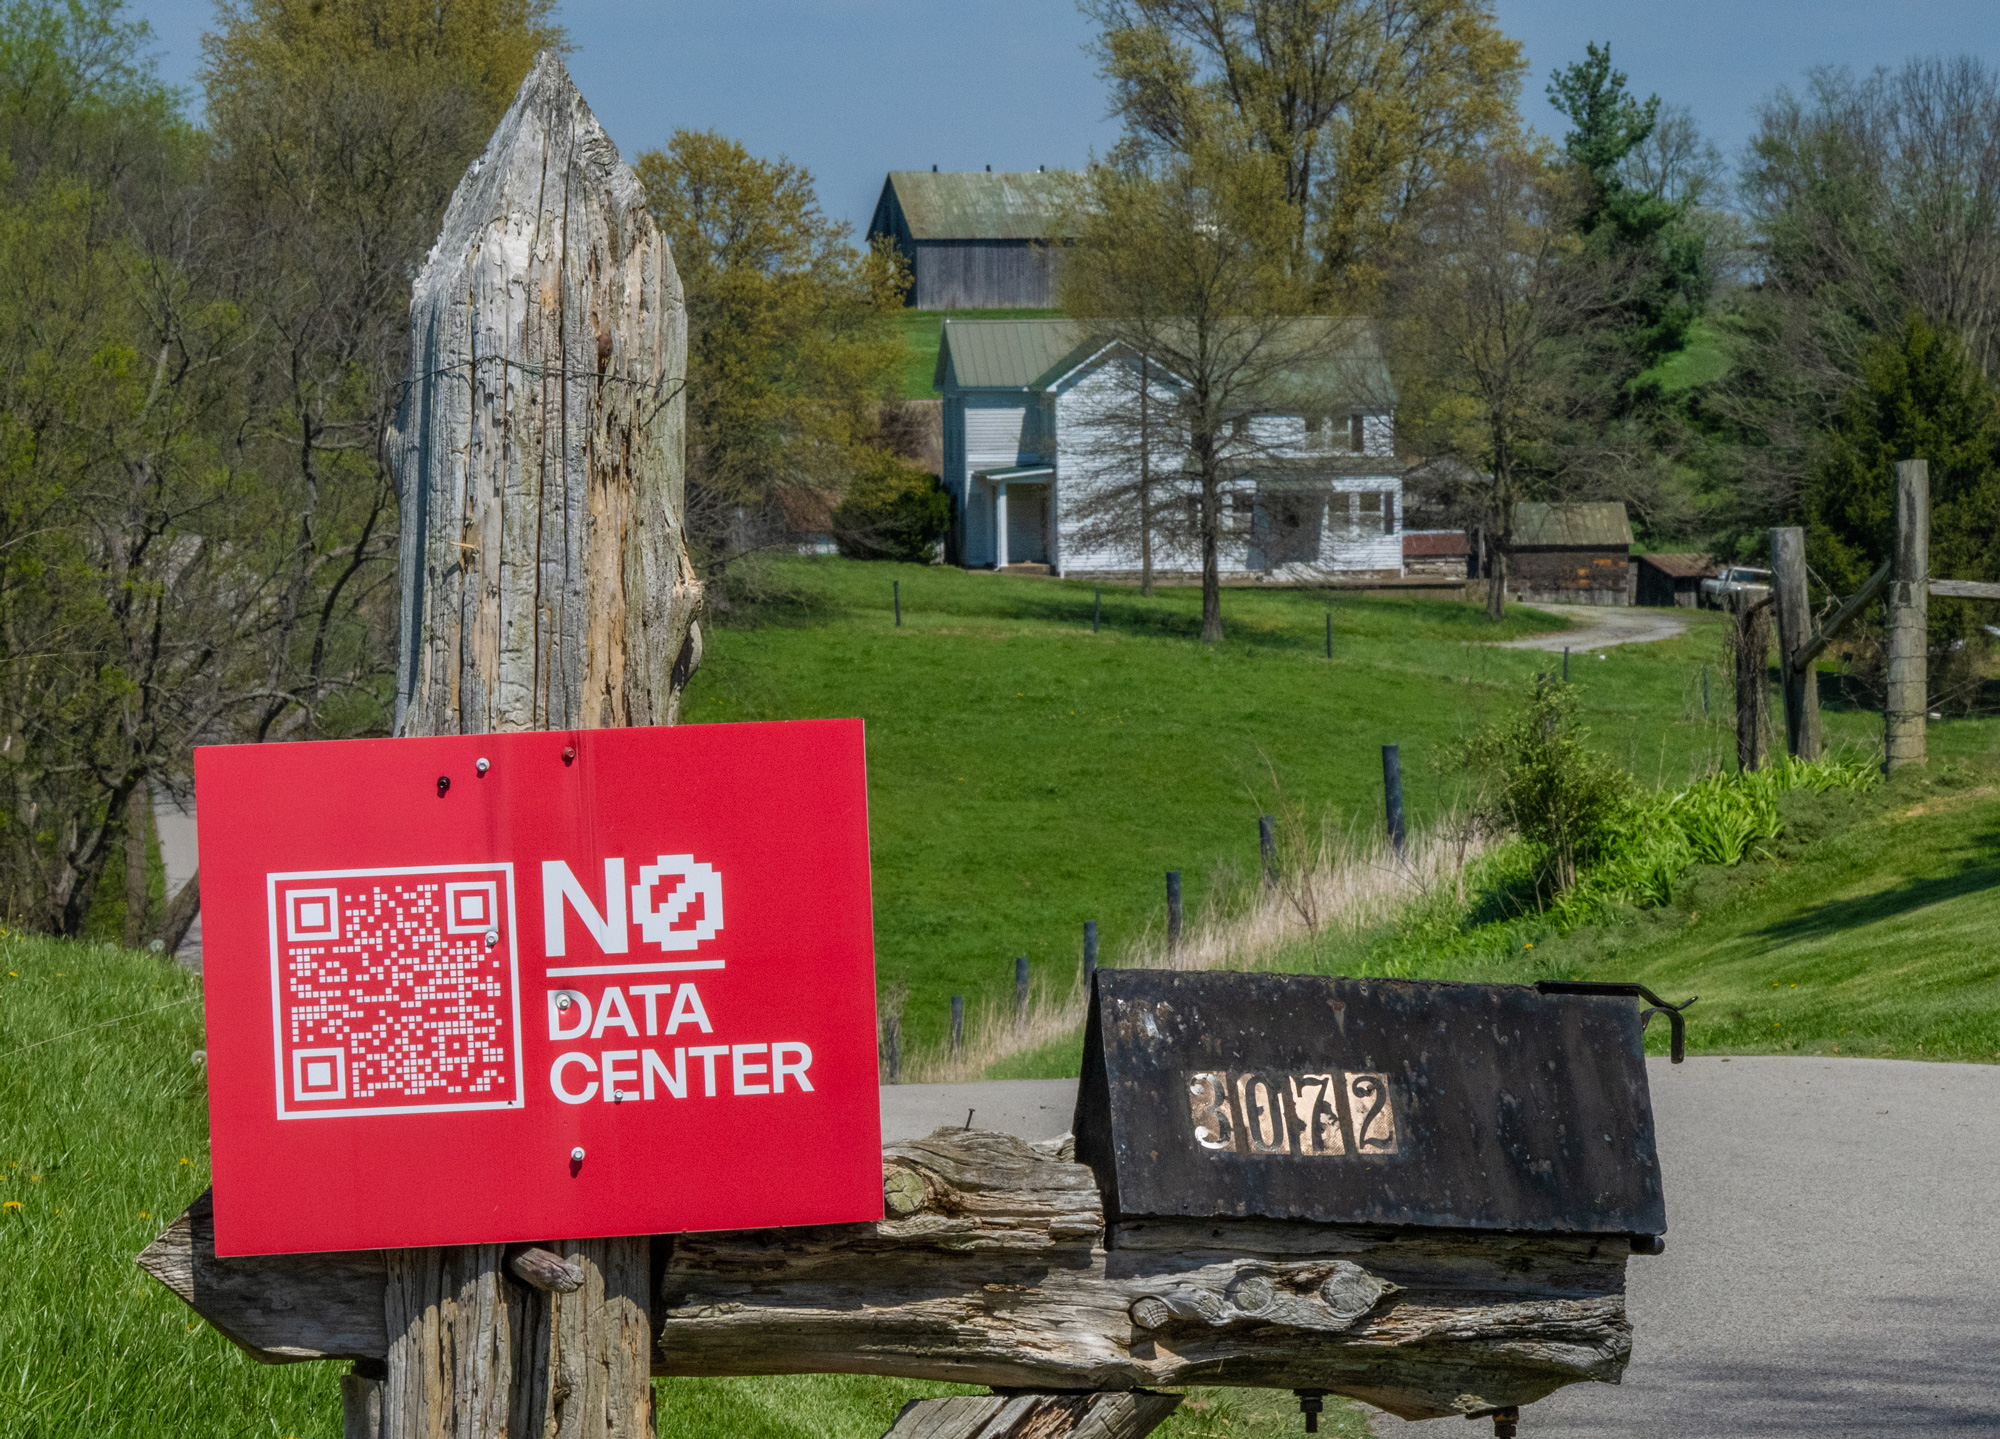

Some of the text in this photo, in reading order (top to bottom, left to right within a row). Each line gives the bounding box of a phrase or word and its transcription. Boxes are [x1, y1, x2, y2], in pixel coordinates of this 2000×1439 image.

[542, 854, 724, 957] NO
[547, 983, 713, 1041] DATA
[550, 1042, 815, 1105] CENTER
[1190, 1072, 1394, 1152] 3072
